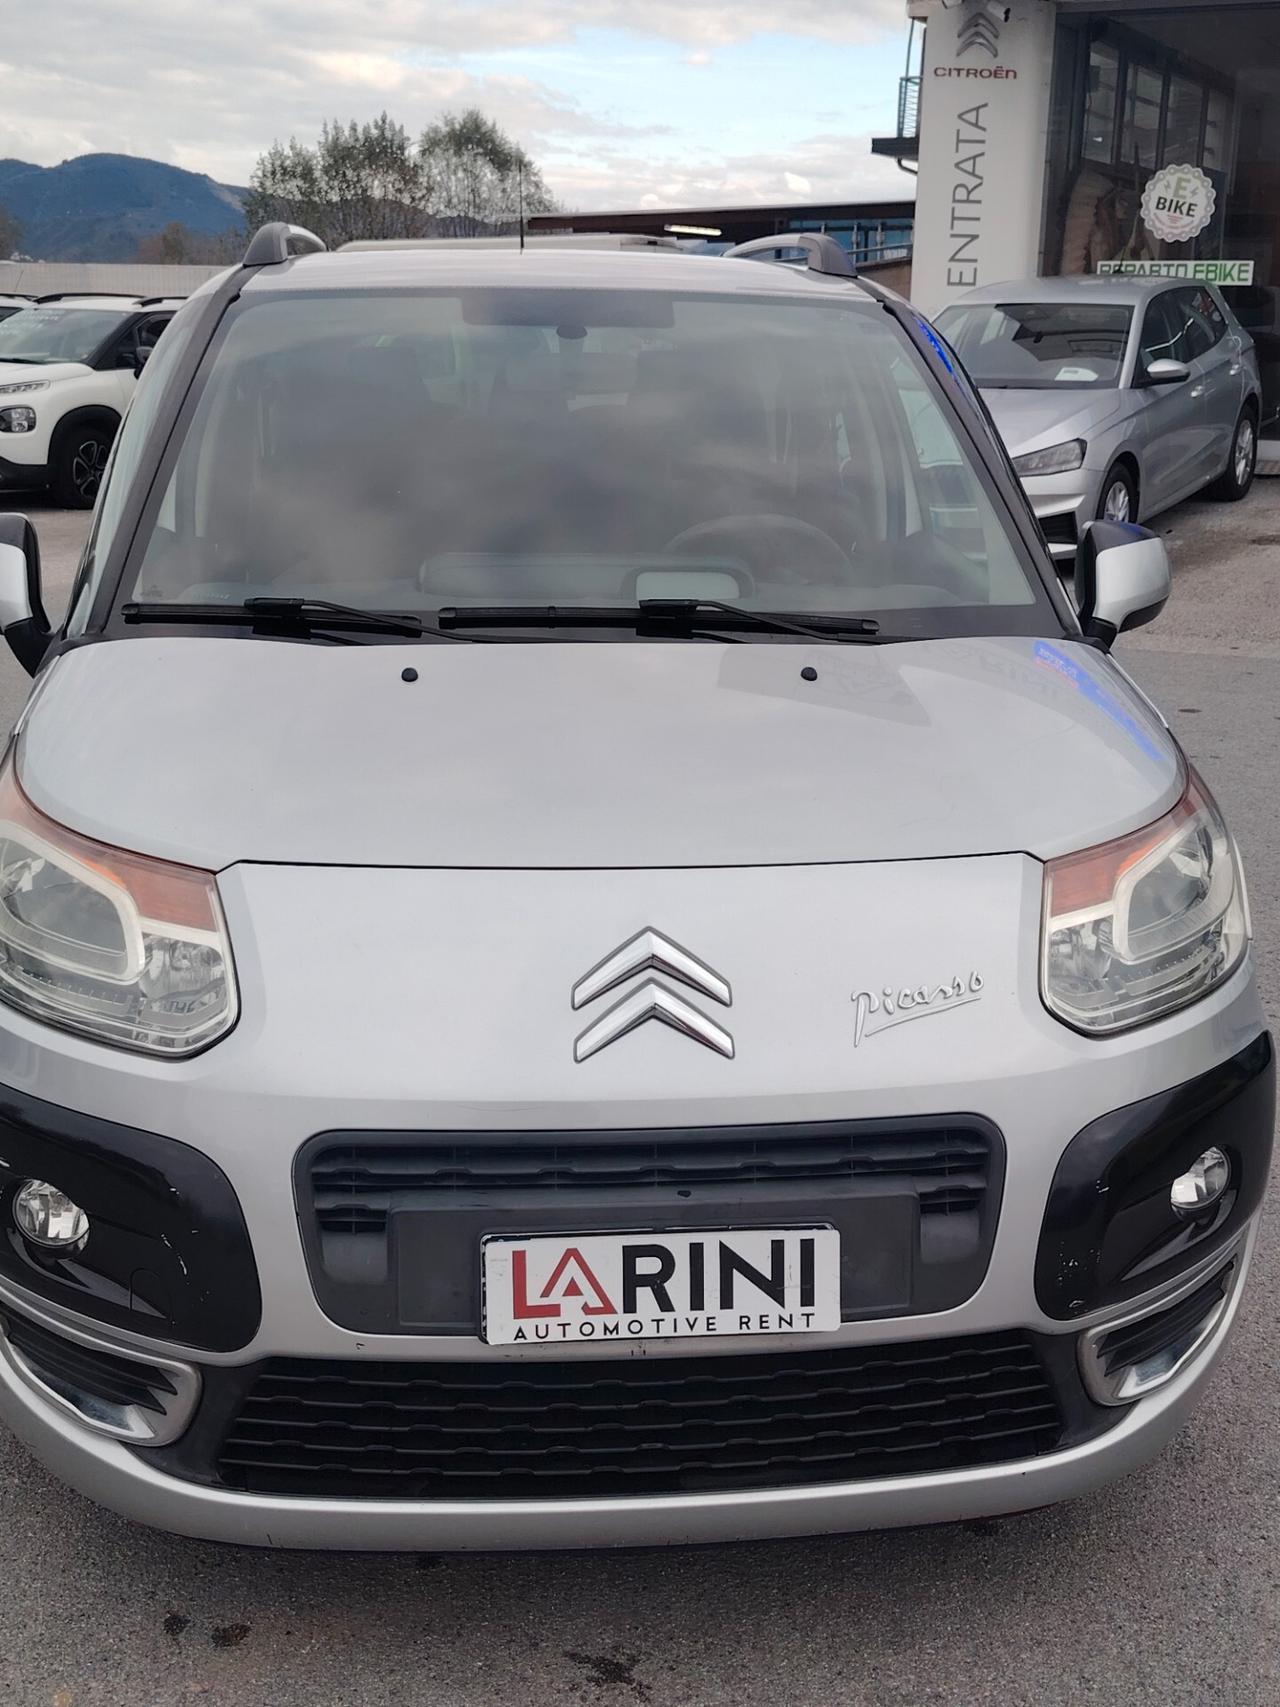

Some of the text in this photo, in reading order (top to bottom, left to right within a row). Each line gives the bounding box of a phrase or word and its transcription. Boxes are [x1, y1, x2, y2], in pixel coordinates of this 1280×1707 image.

[946, 102, 989, 288] ENTRATA
[1155, 195, 1198, 218] BIKE
[1172, 176, 1192, 199] E
[851, 970, 985, 1048] Picasso
[511, 1237, 816, 1320] LARINI
[513, 1312, 816, 1341] AUTOMOTIVE RENT
